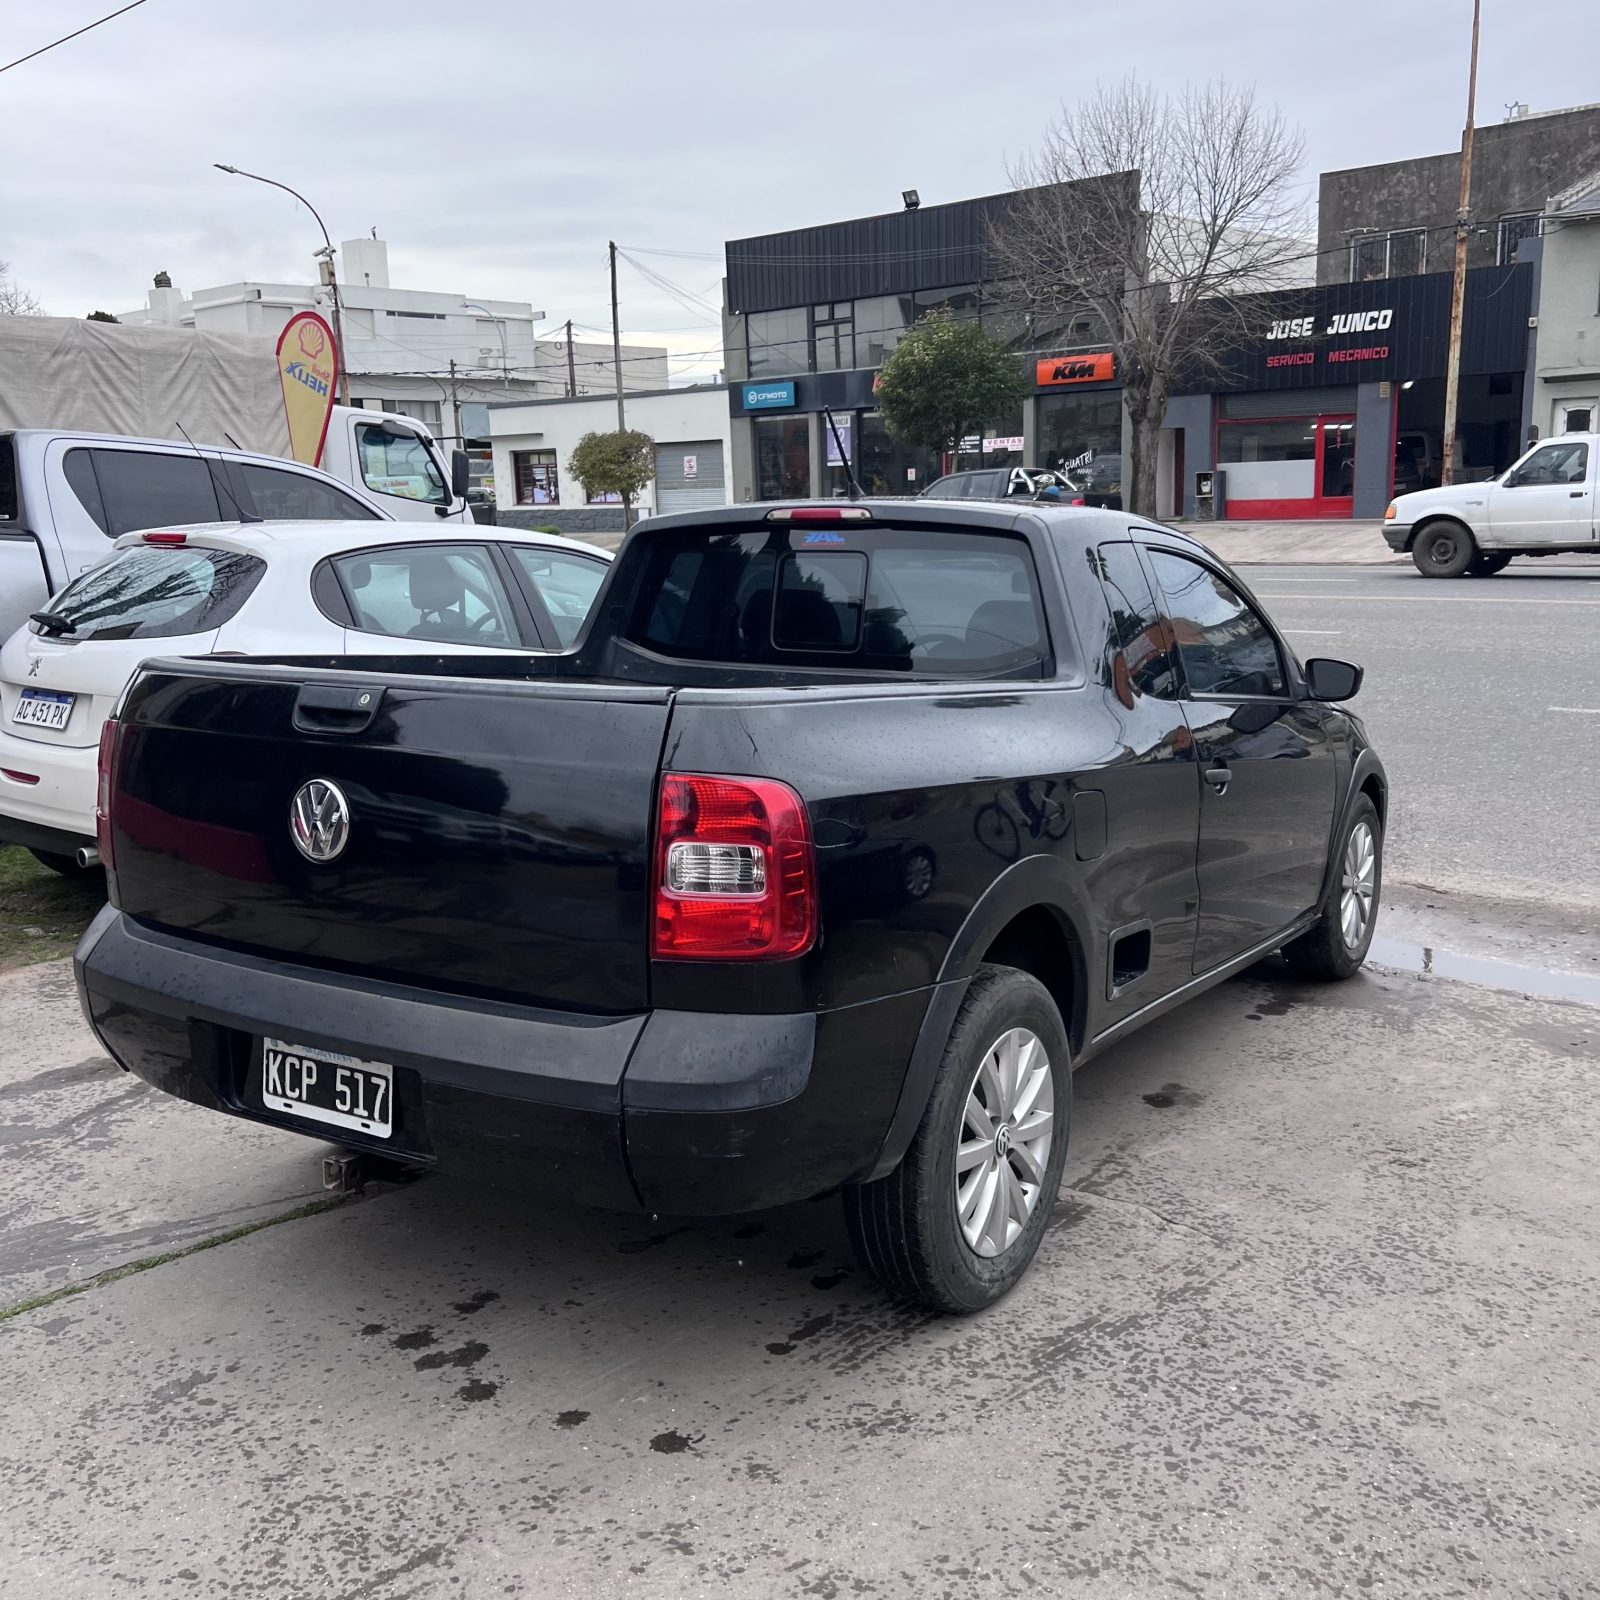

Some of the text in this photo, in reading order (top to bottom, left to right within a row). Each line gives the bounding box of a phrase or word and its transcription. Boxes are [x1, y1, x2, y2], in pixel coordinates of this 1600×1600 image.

[1266, 309, 1393, 340] JOSE JUNCO
[1266, 346, 1389, 367] SERVICIO MECANICO
[1052, 361, 1096, 380] KTM
[757, 391, 787, 400] CFMOTO
[987, 437, 1022, 446] VENTAS
[1064, 450, 1092, 470] CUATRI
[16, 700, 67, 725] AC 451 PK
[267, 1051, 387, 1123] KCP 517
